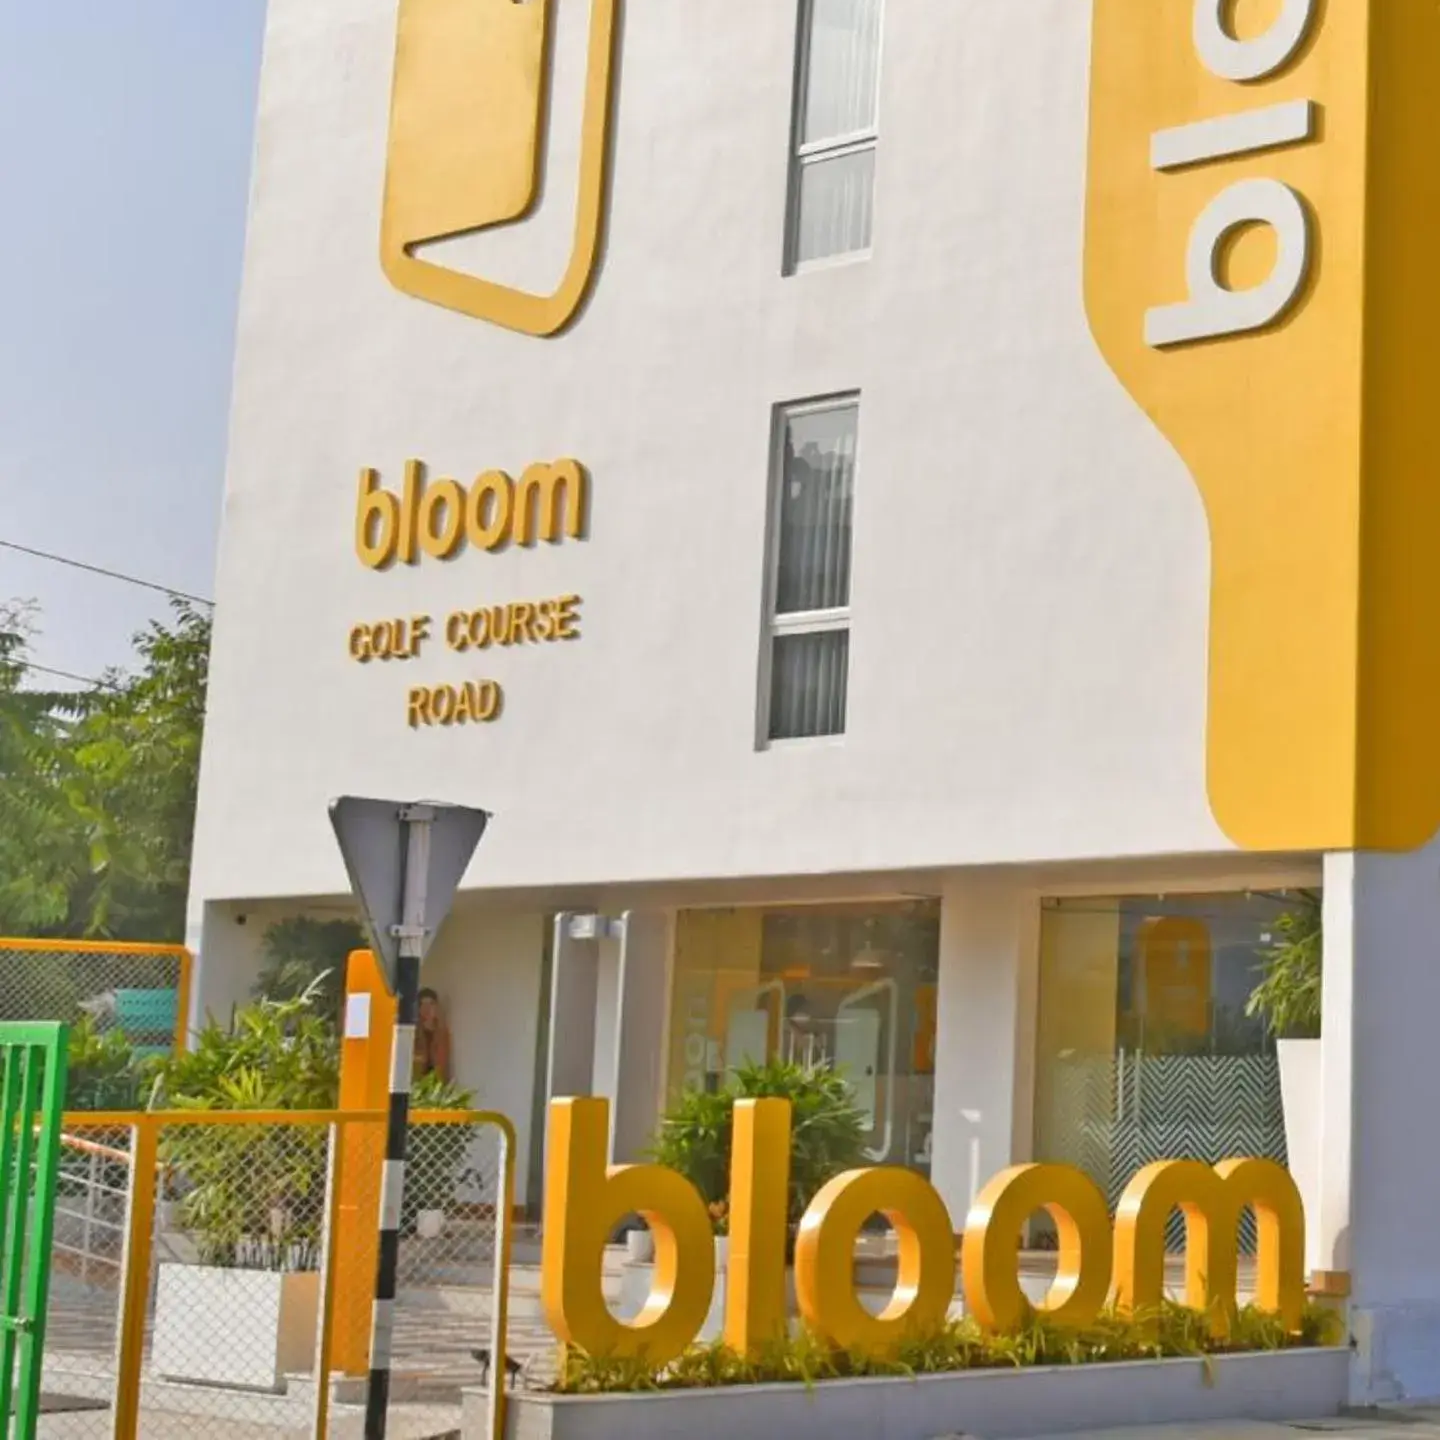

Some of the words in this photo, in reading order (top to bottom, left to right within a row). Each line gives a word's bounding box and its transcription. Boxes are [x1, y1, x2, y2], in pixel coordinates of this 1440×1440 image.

[355, 457, 592, 572] bloom
[349, 615, 431, 663] GOLF
[445, 593, 583, 652] COURSE
[407, 676, 503, 730] ROAD
[541, 1096, 1305, 1366] bloom
